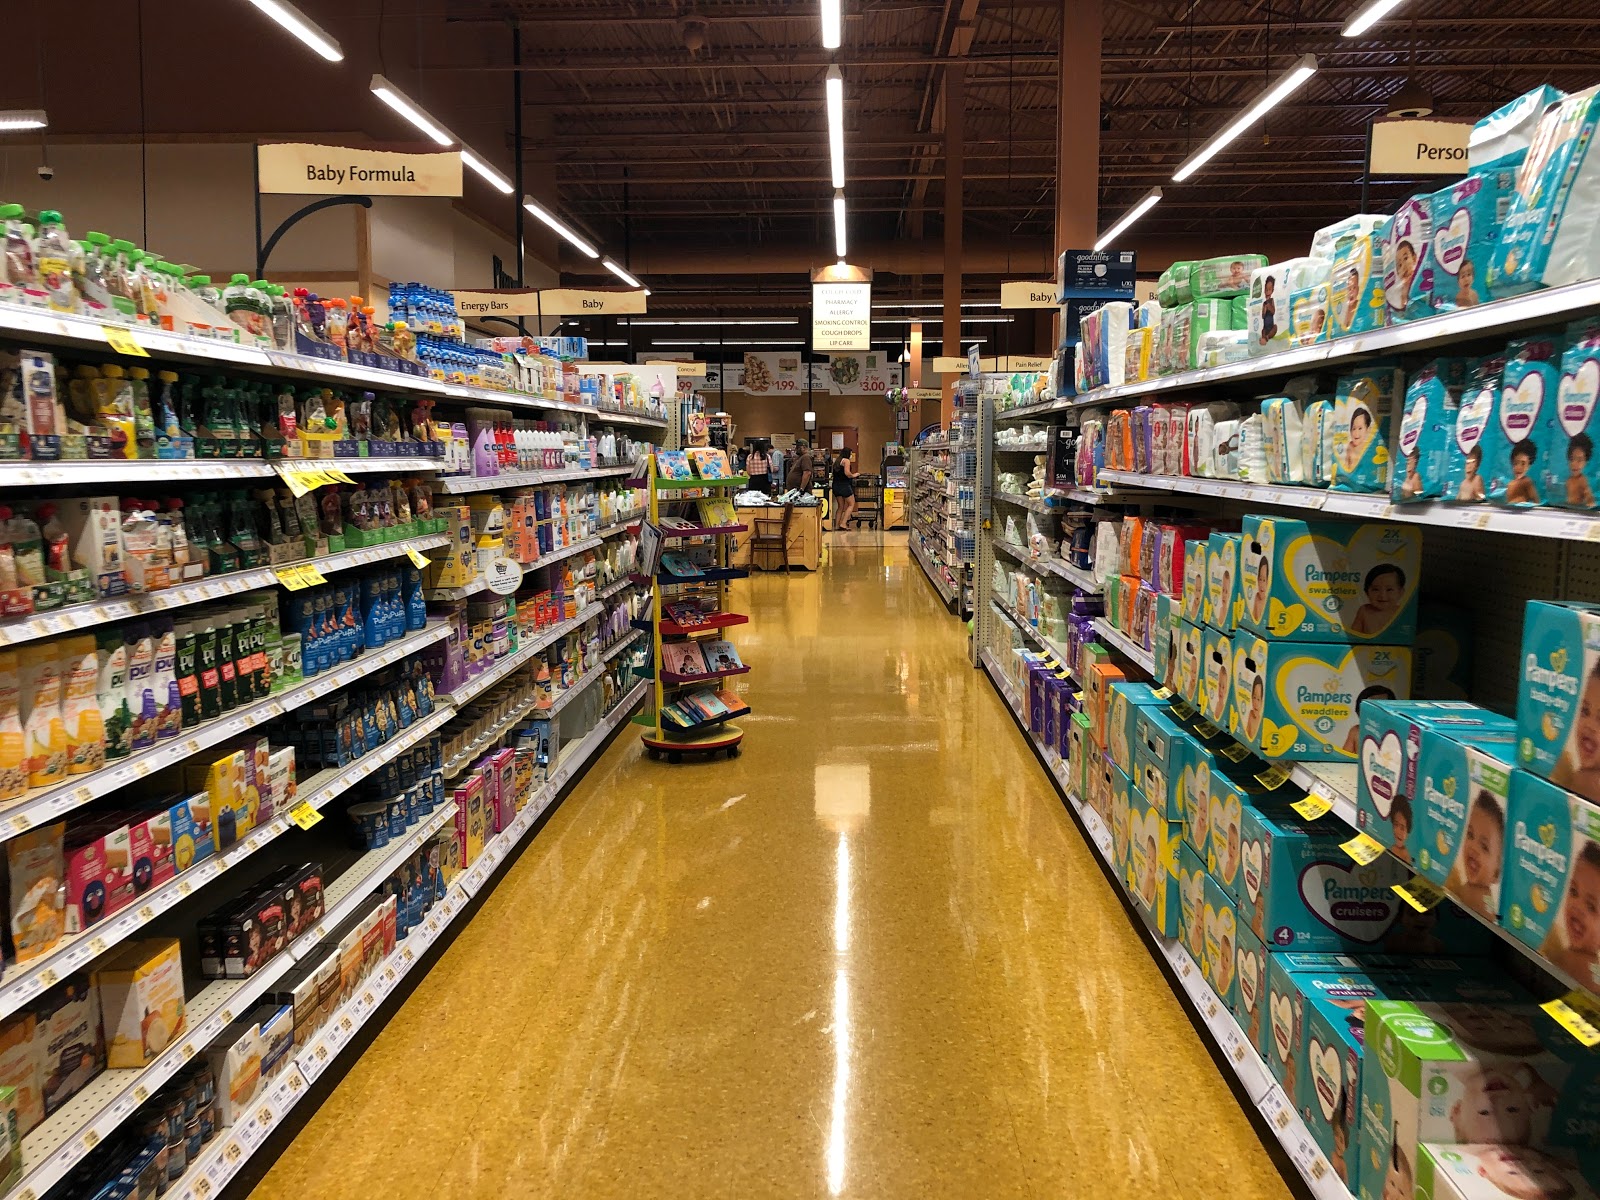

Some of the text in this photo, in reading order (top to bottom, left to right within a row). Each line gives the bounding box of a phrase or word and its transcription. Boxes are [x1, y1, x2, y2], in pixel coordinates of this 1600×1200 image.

[306, 165, 415, 186] Baby Formula
[1076, 250, 1110, 264] goodnites
[1030, 292, 1052, 303] Baby
[461, 299, 509, 312] Energy Bars
[582, 298, 604, 310] Baby
[860, 381, 886, 392] $3.00
[1383, 528, 1400, 540] 2X
[1305, 564, 1361, 584] Pampers
[1308, 586, 1357, 596] swaddlers
[1277, 612, 1287, 625] 5
[1300, 623, 1314, 632] 58
[1374, 651, 1391, 662] 2X
[1525, 652, 1579, 696] Pampers
[1297, 685, 1352, 704] Pampers
[1300, 708, 1349, 717] swaddlers
[1270, 733, 1279, 745] 5
[1293, 743, 1307, 753] 58
[1423, 776, 1466, 820] Pampers
[1514, 821, 1567, 874] Pampers
[1324, 877, 1396, 902] Pampers
[1335, 906, 1385, 918] cruisers
[1278, 928, 1290, 940] 4
[1312, 979, 1376, 991] Pampers
